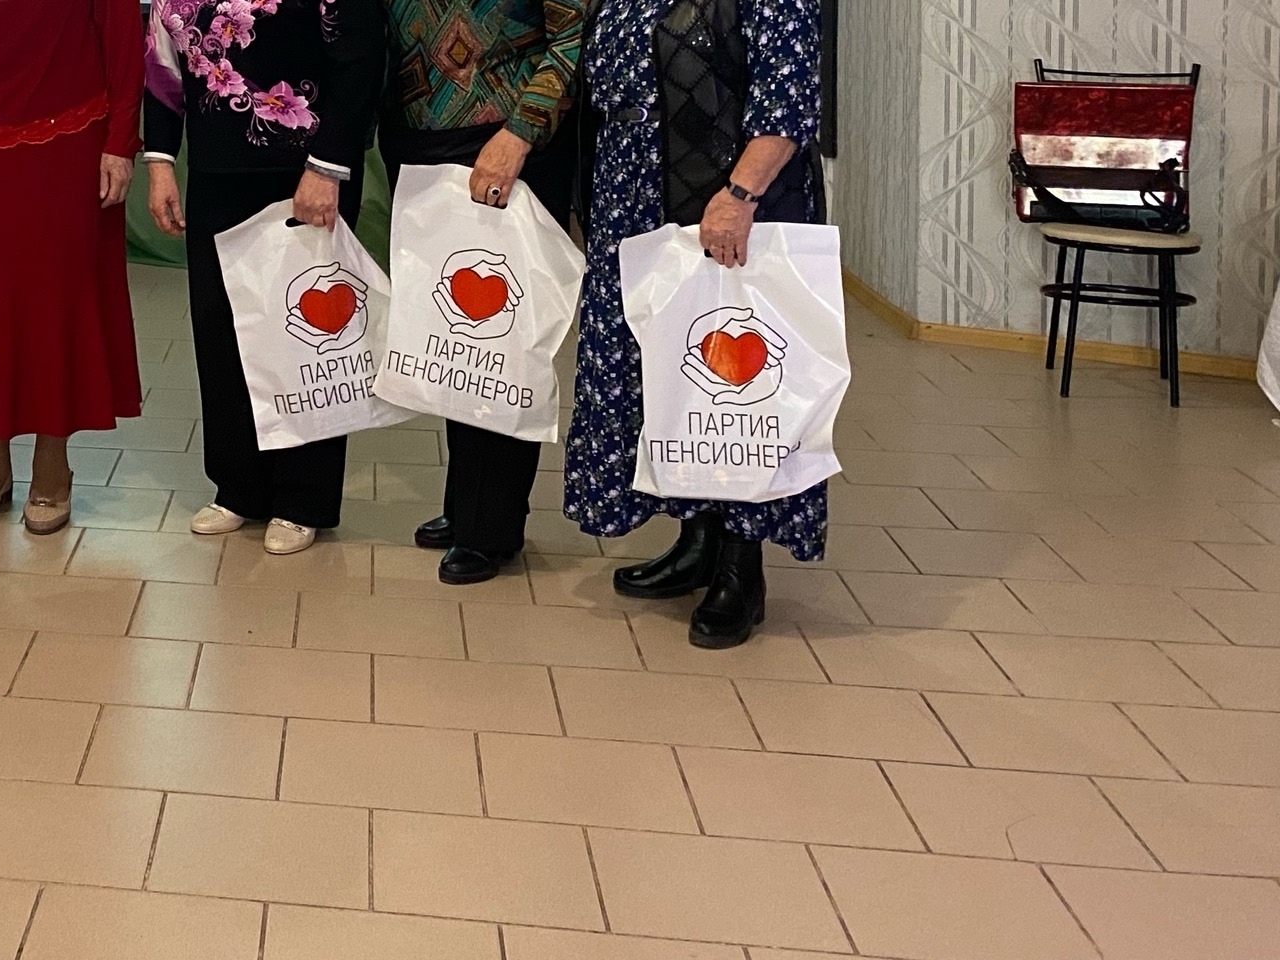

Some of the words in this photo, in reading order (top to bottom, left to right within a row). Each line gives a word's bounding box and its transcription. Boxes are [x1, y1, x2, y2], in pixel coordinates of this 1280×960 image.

[300, 350, 375, 386] ПАРТИЯ
[425, 334, 506, 375] ПАРТИЯ
[274, 373, 377, 415] ПЕНСИОНЕ
[387, 350, 534, 409] ПЕНСИОНЕРОВ
[688, 411, 780, 439] ПАРТИЯ
